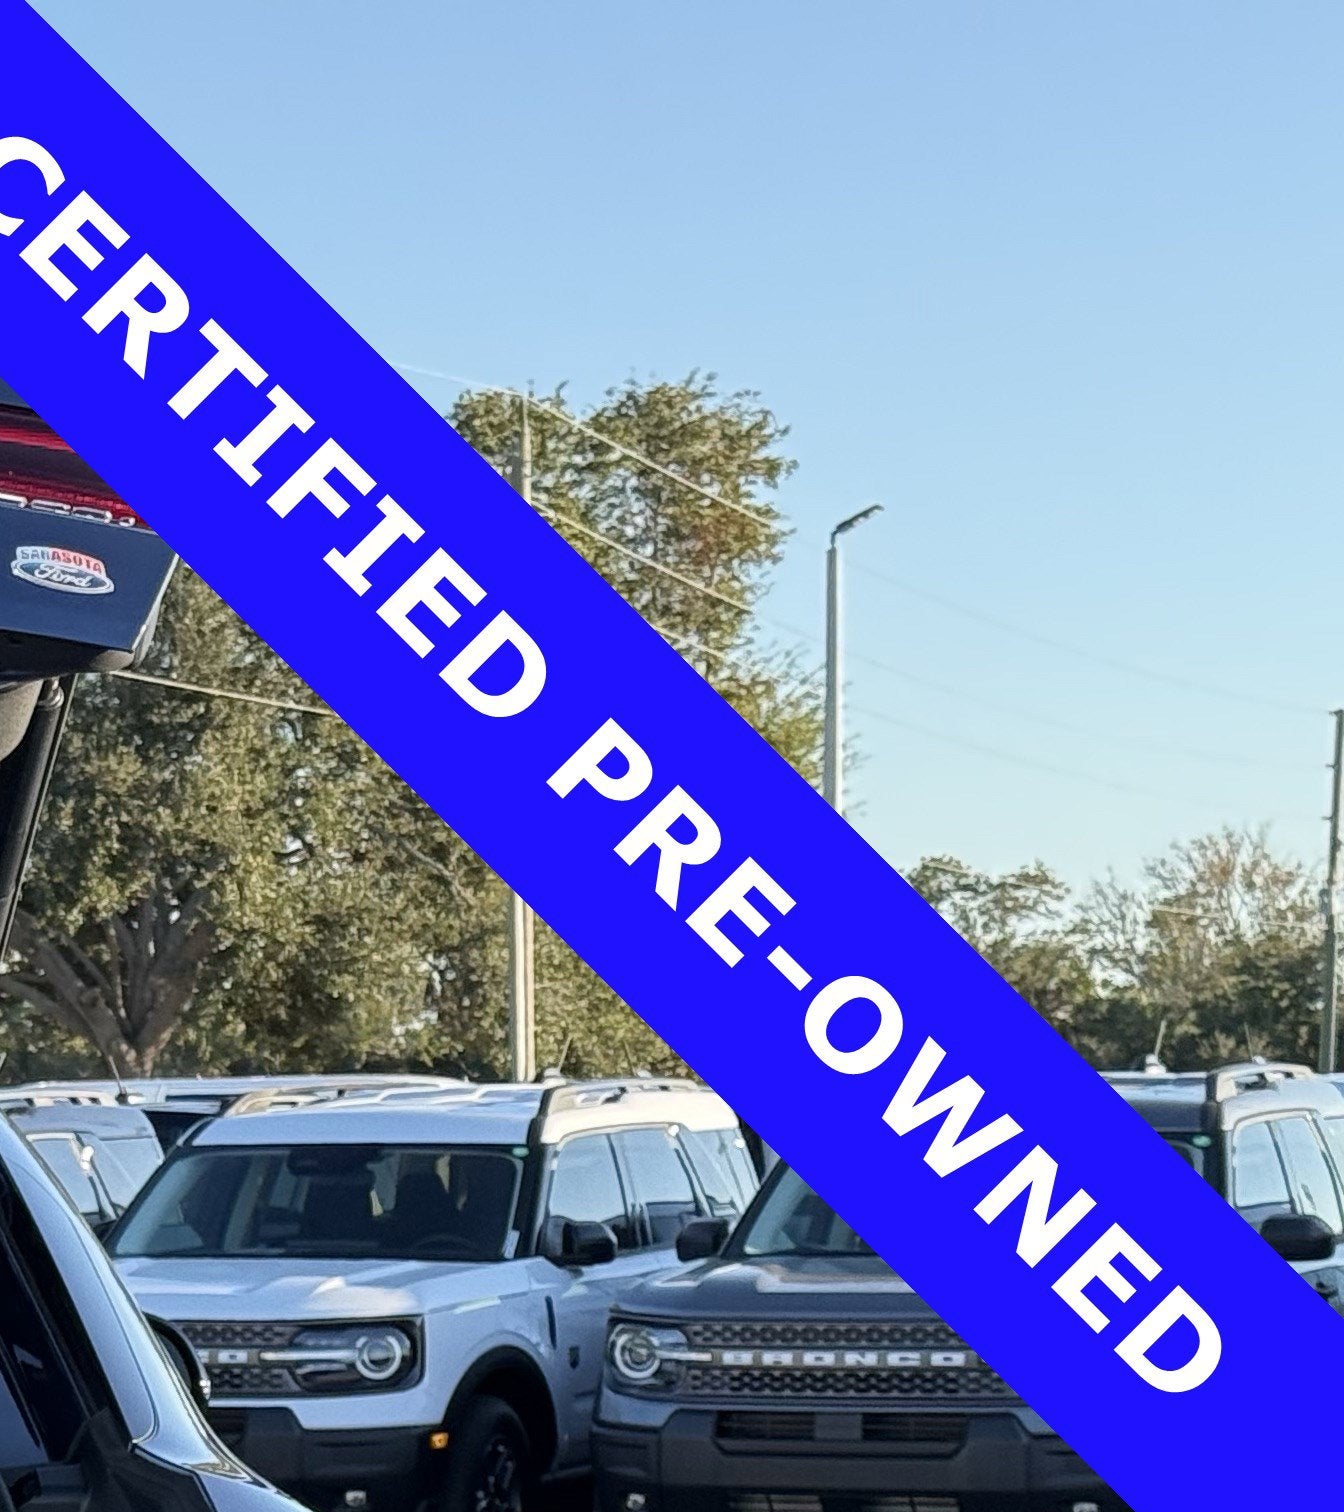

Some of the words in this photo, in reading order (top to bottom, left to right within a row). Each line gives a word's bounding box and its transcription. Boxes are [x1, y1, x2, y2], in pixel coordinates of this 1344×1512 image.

[20, 548, 103, 574] SARASOTA
[34, 563, 92, 587] Ford
[721, 1350, 966, 1367] BRONCO
